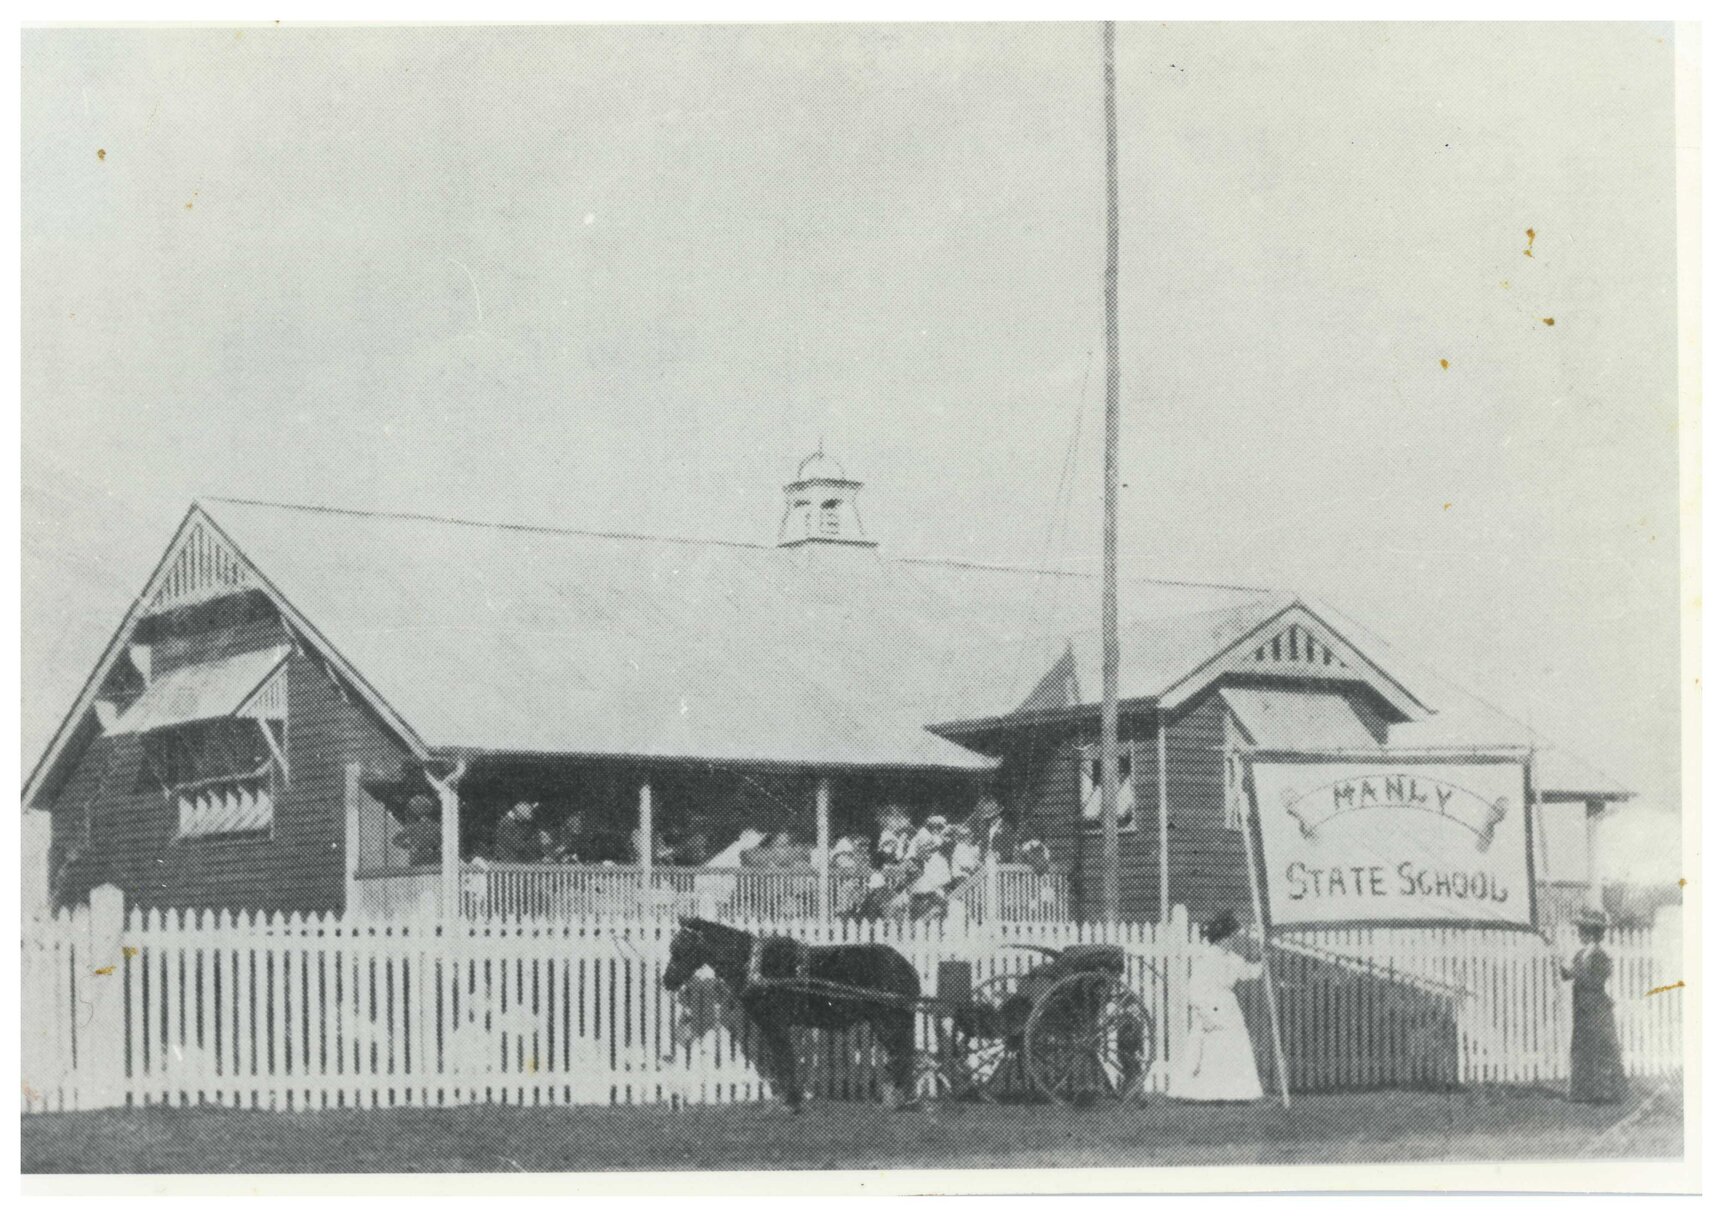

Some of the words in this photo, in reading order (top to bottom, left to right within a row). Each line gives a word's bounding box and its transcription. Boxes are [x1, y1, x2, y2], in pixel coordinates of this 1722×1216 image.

[1333, 776, 1452, 815] MANLY
[1286, 861, 1387, 900] STATE
[1397, 861, 1508, 902] SCHOOL
